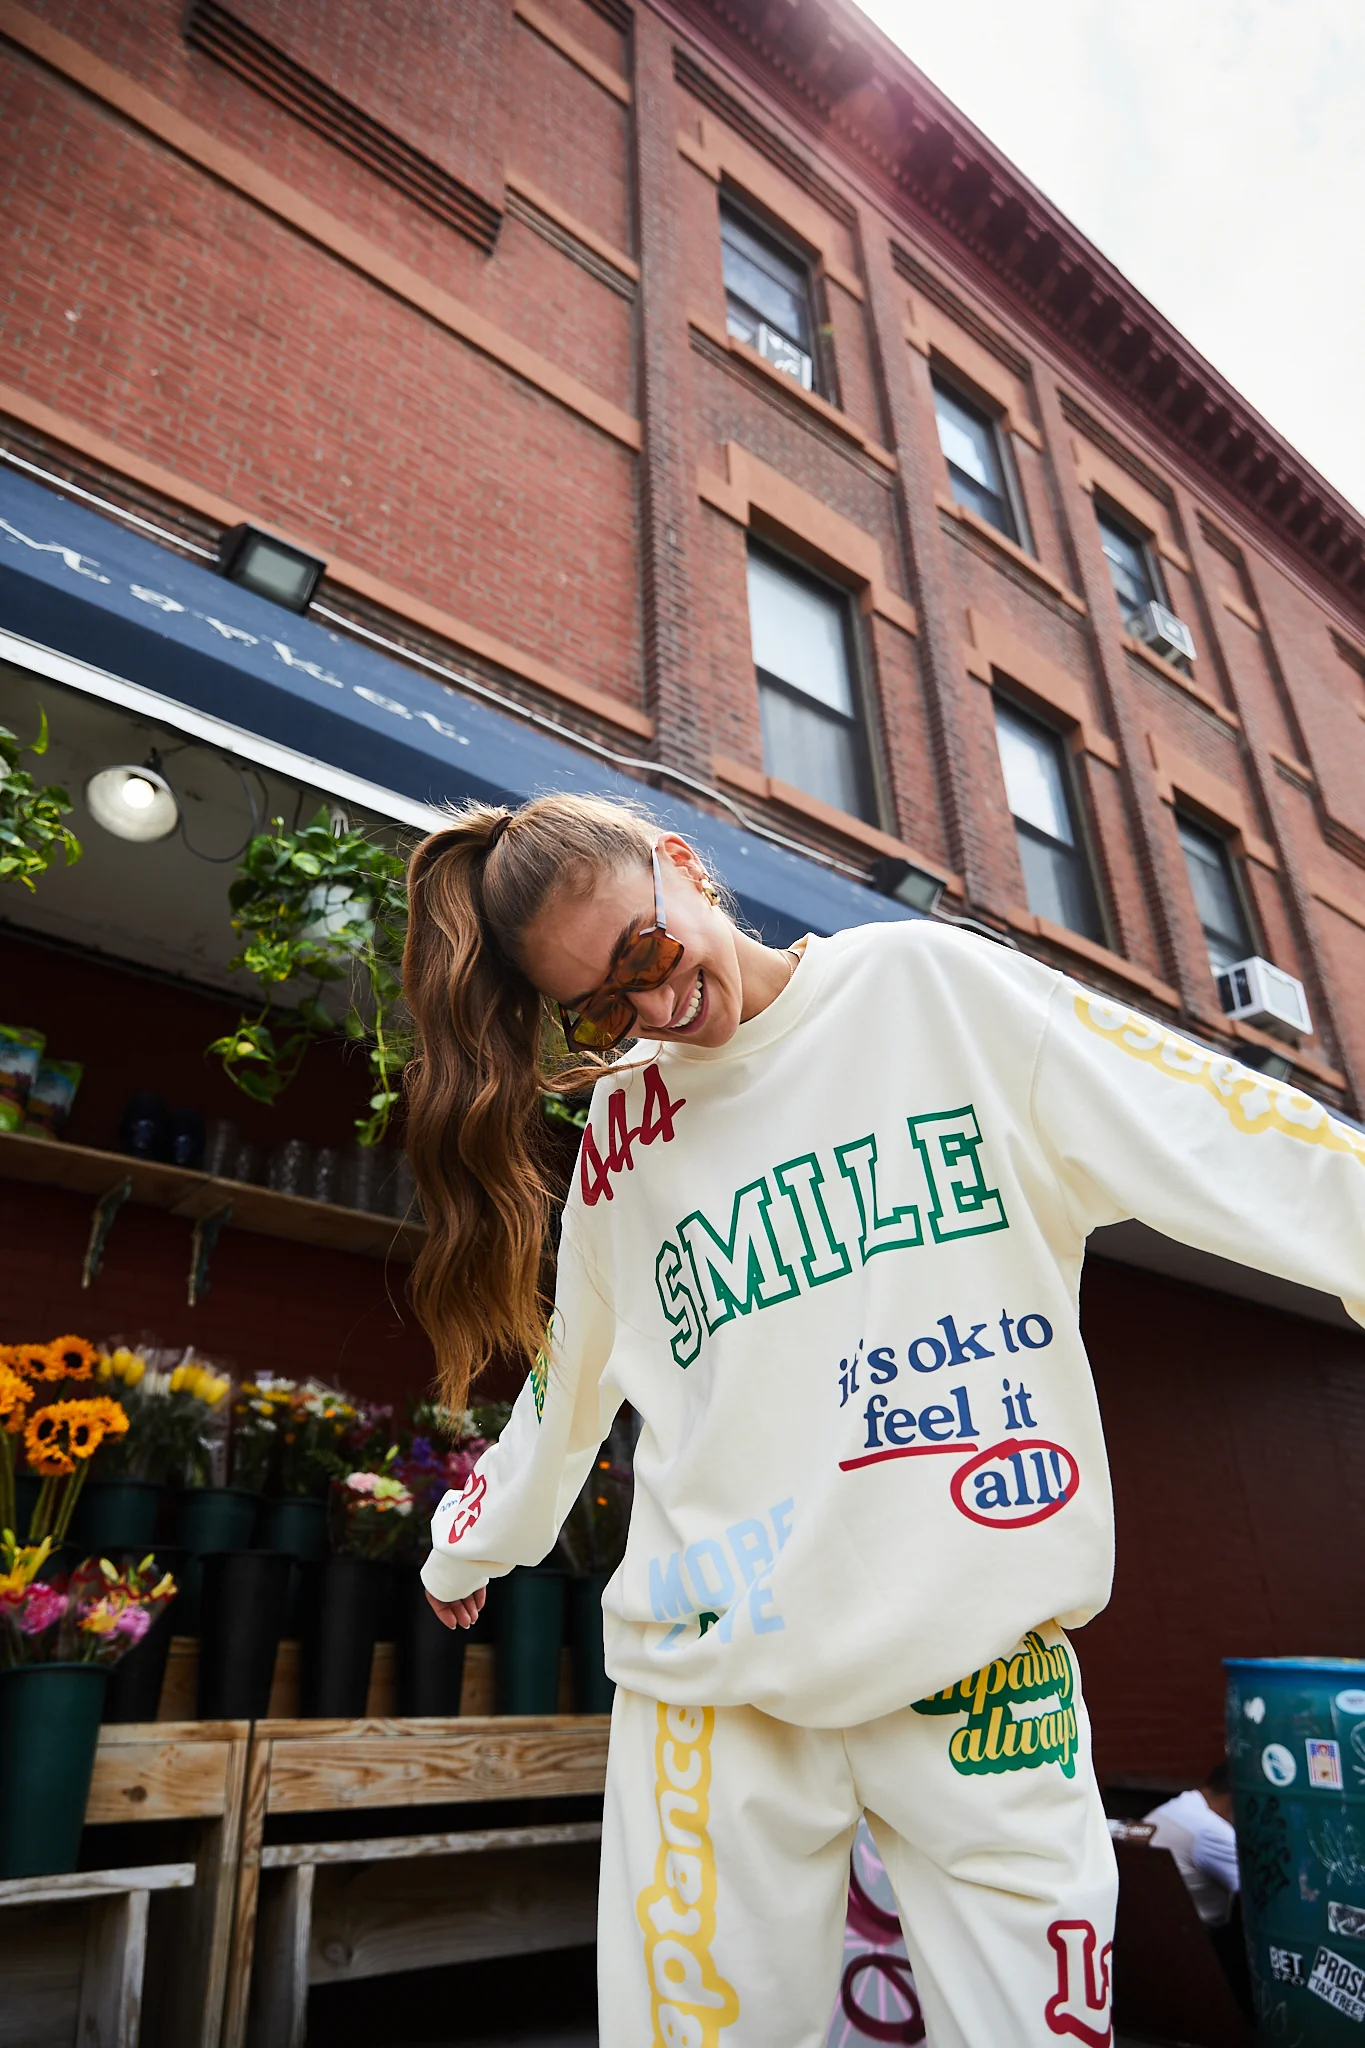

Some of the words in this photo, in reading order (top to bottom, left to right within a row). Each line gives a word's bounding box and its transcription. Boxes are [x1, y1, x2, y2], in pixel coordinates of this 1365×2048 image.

[655, 1104, 1010, 1369] SMILE
[838, 1338, 899, 1408] it's
[908, 1314, 996, 1374] ok
[999, 1308, 1054, 1353] to
[863, 1384, 980, 1448] feel
[1001, 1378, 1038, 1430] it
[973, 1450, 1067, 1509] all!
